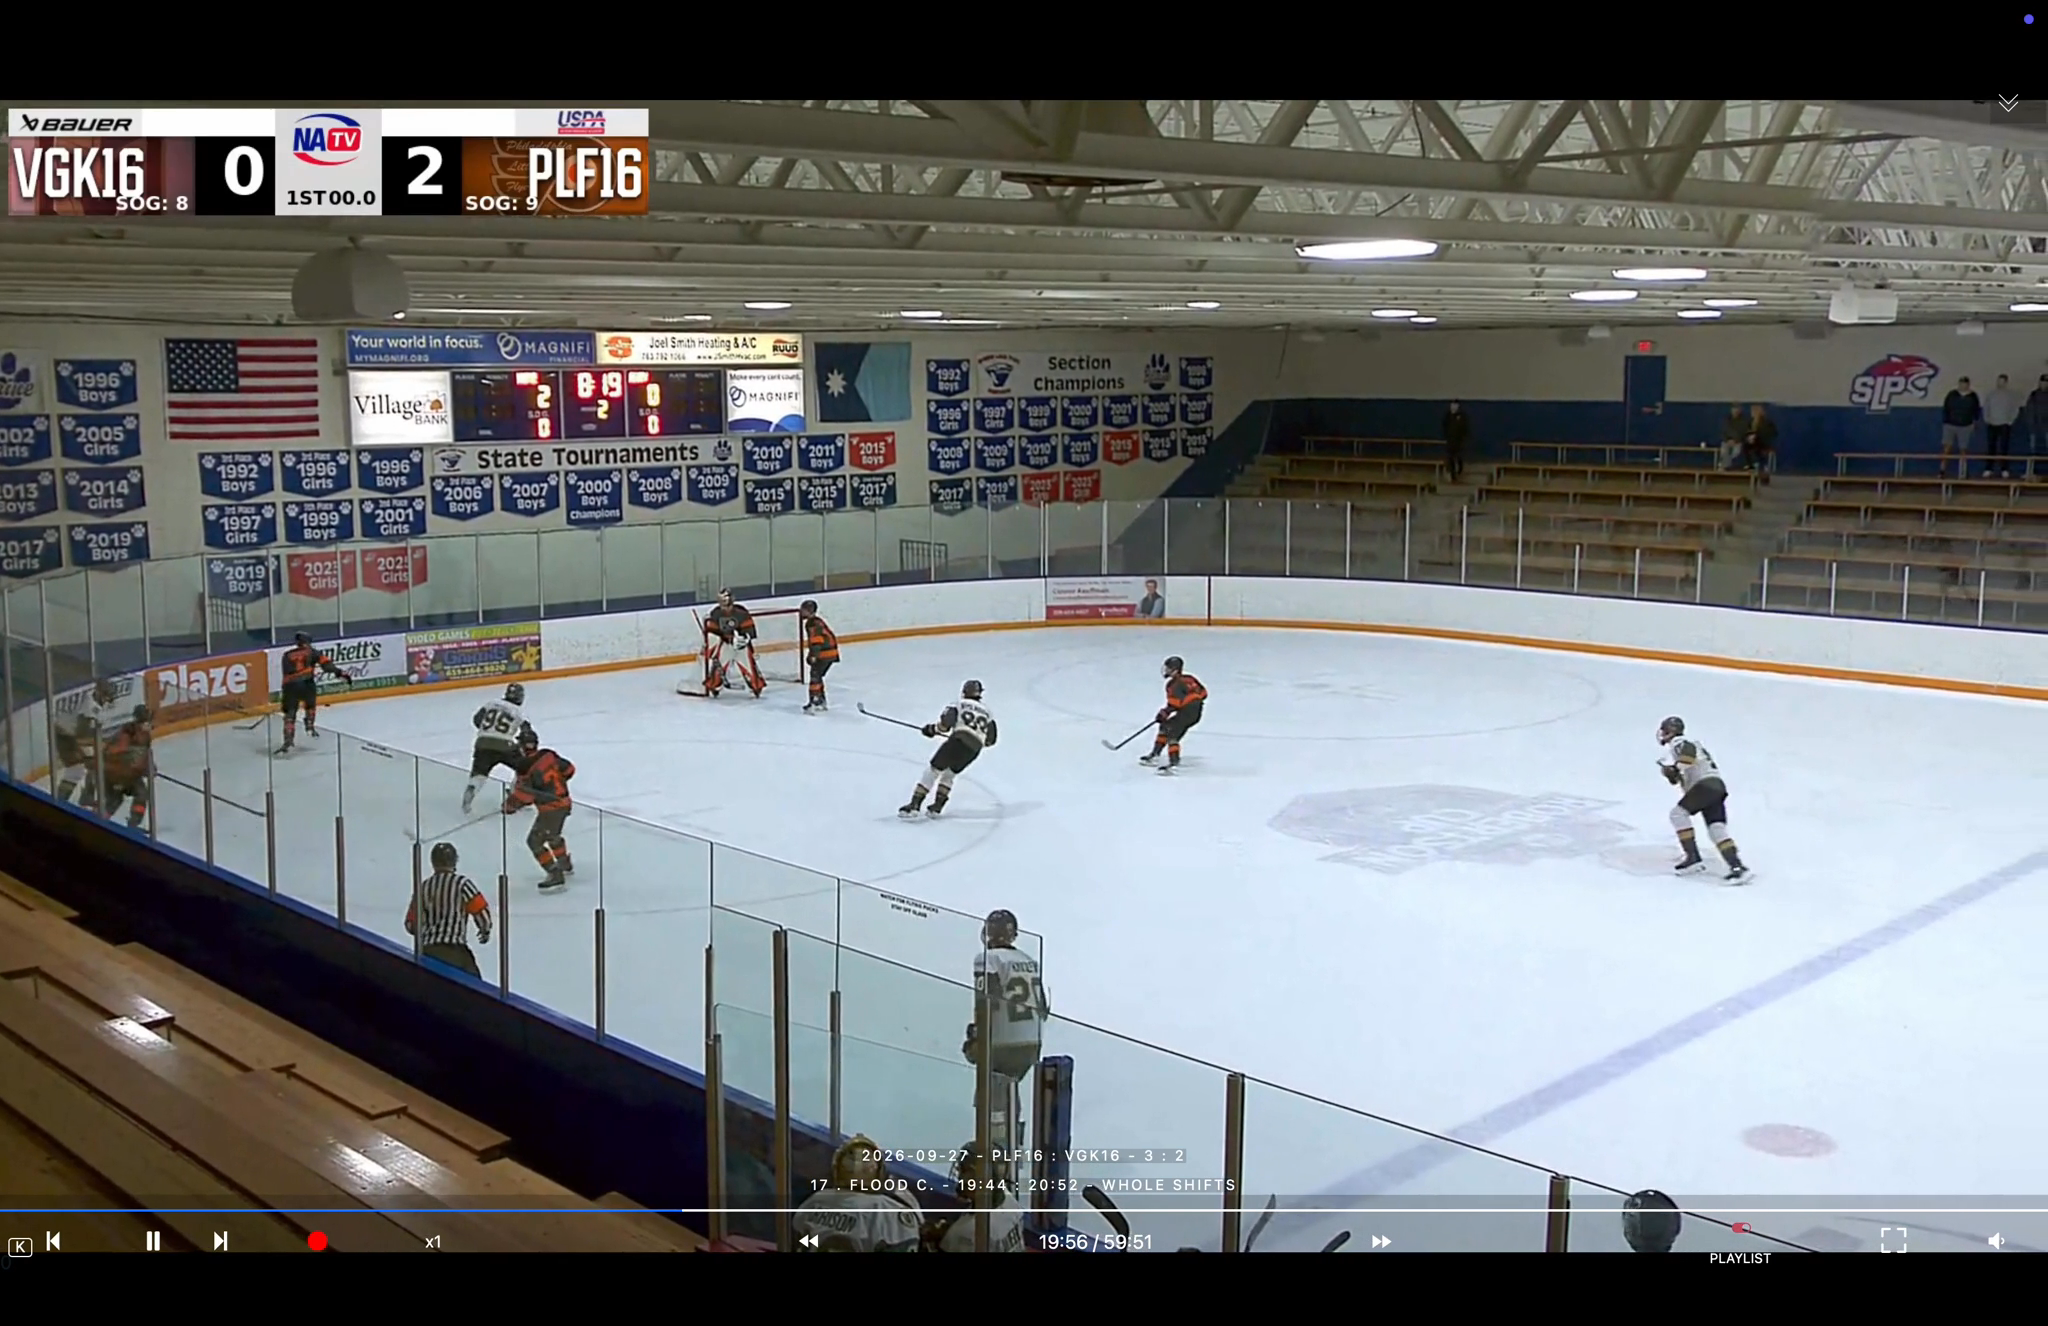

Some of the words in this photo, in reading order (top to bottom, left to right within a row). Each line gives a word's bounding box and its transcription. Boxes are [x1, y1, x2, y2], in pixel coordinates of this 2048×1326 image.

[351, 336, 384, 350] Your
[387, 335, 427, 349] world
[430, 335, 441, 348] in
[445, 335, 483, 349] focus.
[524, 341, 590, 354] MAGNIFI
[649, 337, 669, 348] Joel
[671, 336, 696, 348] Smith
[698, 337, 731, 351] Heating
[733, 337, 740, 349] &
[772, 344, 799, 353] RUUD
[1048, 356, 1111, 371] Section
[73, 372, 121, 389] 1996
[936, 368, 962, 381] 1992
[1034, 376, 1125, 392] Champions
[78, 390, 117, 404] Boys
[537, 384, 551, 409] 2
[749, 393, 799, 402] MAGNIFI
[355, 394, 424, 420] Village
[596, 399, 608, 420] 2
[415, 414, 448, 425] BANK
[75, 426, 125, 442] 2005
[84, 443, 120, 457] Girls
[752, 446, 783, 460] 2010
[808, 444, 835, 458] 2011
[859, 442, 886, 455] 2015
[477, 448, 543, 469] State
[552, 443, 699, 467] Tournaments
[862, 455, 884, 465] Boys
[296, 463, 338, 478] 1996
[372, 460, 411, 475] 1996
[757, 461, 780, 471] Boys
[811, 458, 833, 469] Boys
[216, 464, 259, 480] 1992
[221, 480, 256, 493] Boys
[302, 478, 334, 490] Girls
[376, 475, 408, 488] Boys
[576, 480, 612, 495] 2000
[639, 477, 672, 492] 2008
[698, 474, 730, 488] 2009
[0, 483, 39, 500] 013
[79, 480, 131, 497] 2014
[443, 486, 483, 501] 2006
[512, 483, 549, 498] 2007
[702, 488, 726, 500] Boys
[754, 488, 785, 502] 2015
[808, 486, 837, 499] 2015
[859, 483, 887, 496] 2017
[938, 488, 964, 501] 2017
[88, 497, 124, 510] Girls
[581, 495, 609, 507] Boys
[643, 491, 668, 503] Boys
[812, 499, 833, 509] Girls
[863, 496, 884, 505] Girls
[449, 501, 479, 514] Boys
[517, 498, 546, 511] Boys
[757, 502, 782, 513] Boys
[299, 511, 339, 526] 1999
[375, 508, 415, 524] 2001
[570, 508, 621, 521] Champions
[219, 516, 261, 531] 1997
[380, 524, 410, 535] Girls
[86, 532, 132, 549] 2019
[225, 531, 258, 544] Girls
[304, 527, 336, 540] Boys
[92, 548, 129, 562] Boys
[2, 557, 40, 571] Girls
[224, 565, 266, 580] 2019
[229, 580, 263, 593] Boys
[406, 632, 436, 644] VIDEO
[438, 630, 470, 641] GAMES
[158, 662, 248, 708] Blaze
